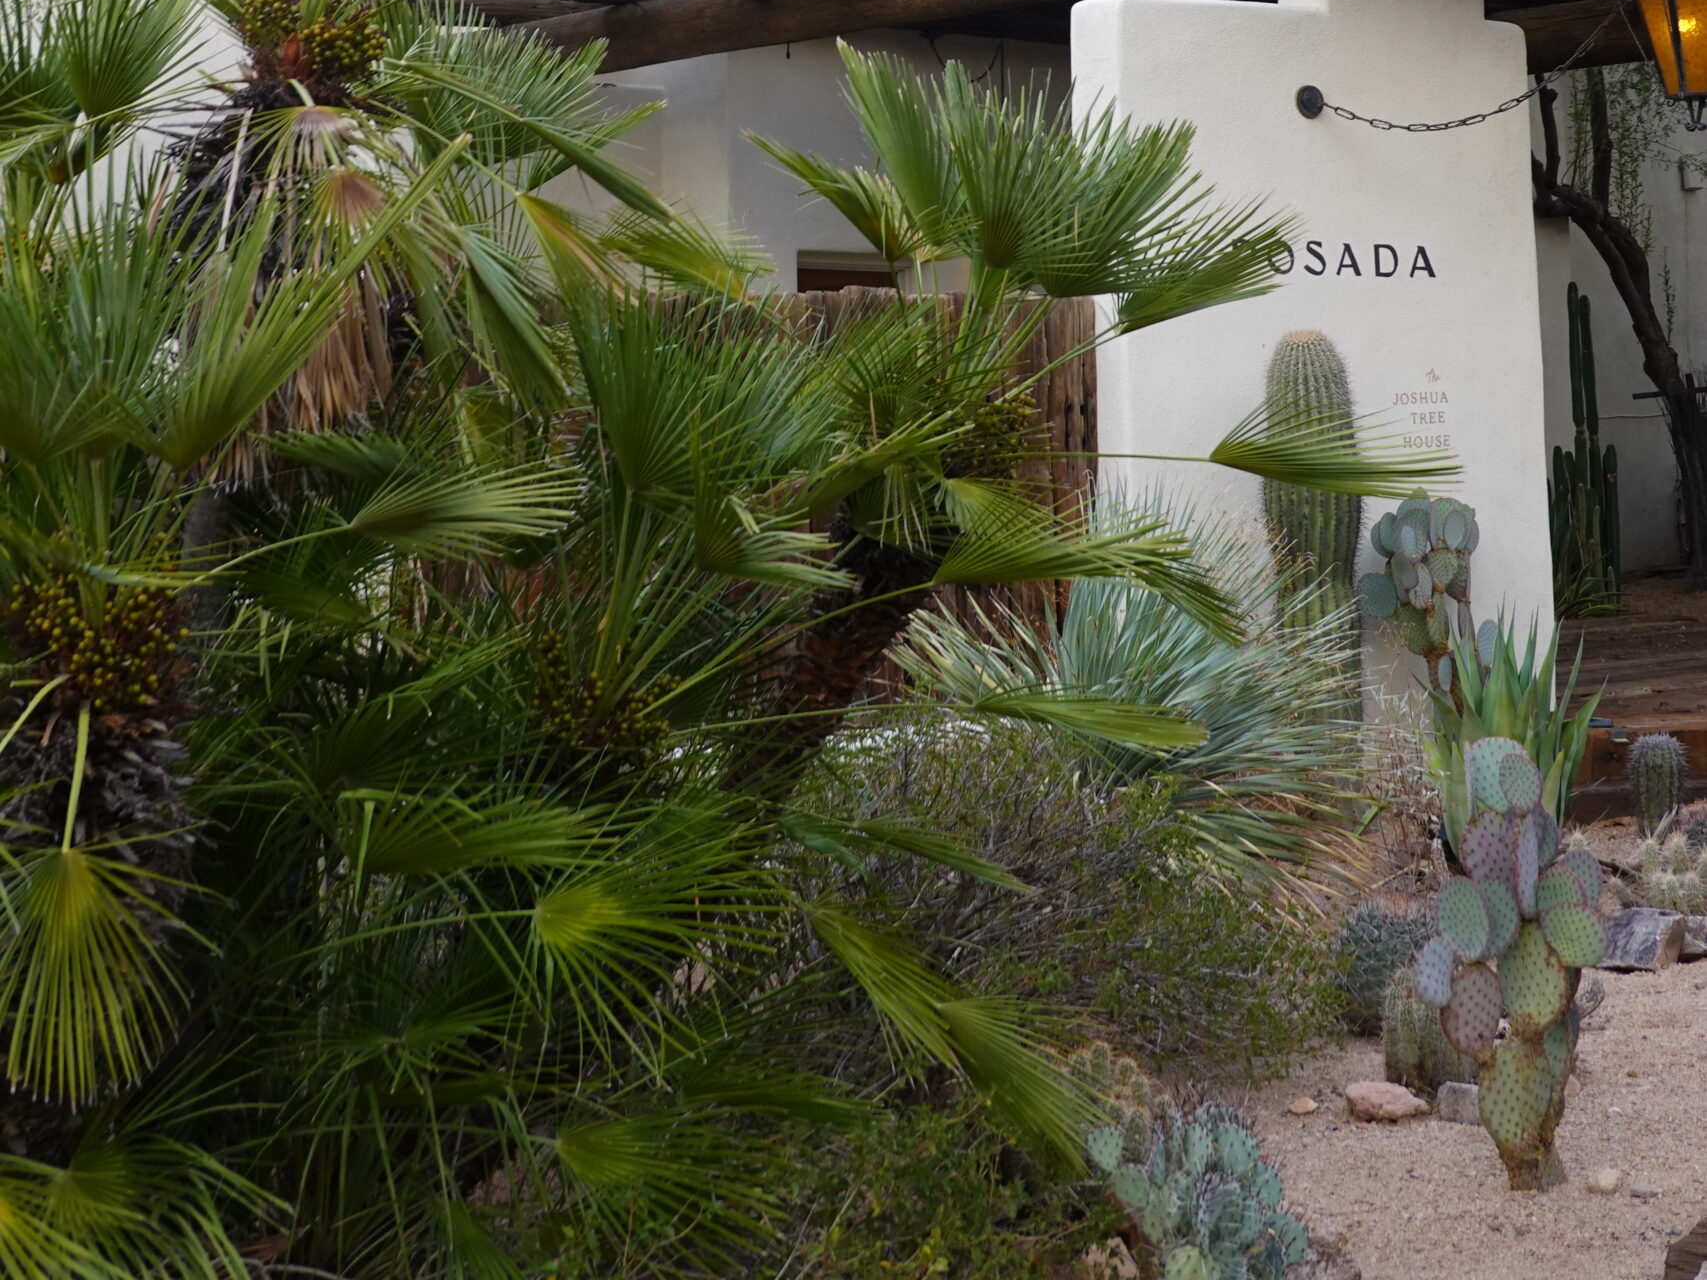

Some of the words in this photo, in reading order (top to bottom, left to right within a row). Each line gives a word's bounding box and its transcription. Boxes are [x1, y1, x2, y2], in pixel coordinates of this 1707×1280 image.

[1425, 368, 1441, 385] The
[1392, 391, 1449, 406] JOSHUA
[1410, 410, 1446, 425] TREE
[1403, 434, 1451, 449] HOUSE
